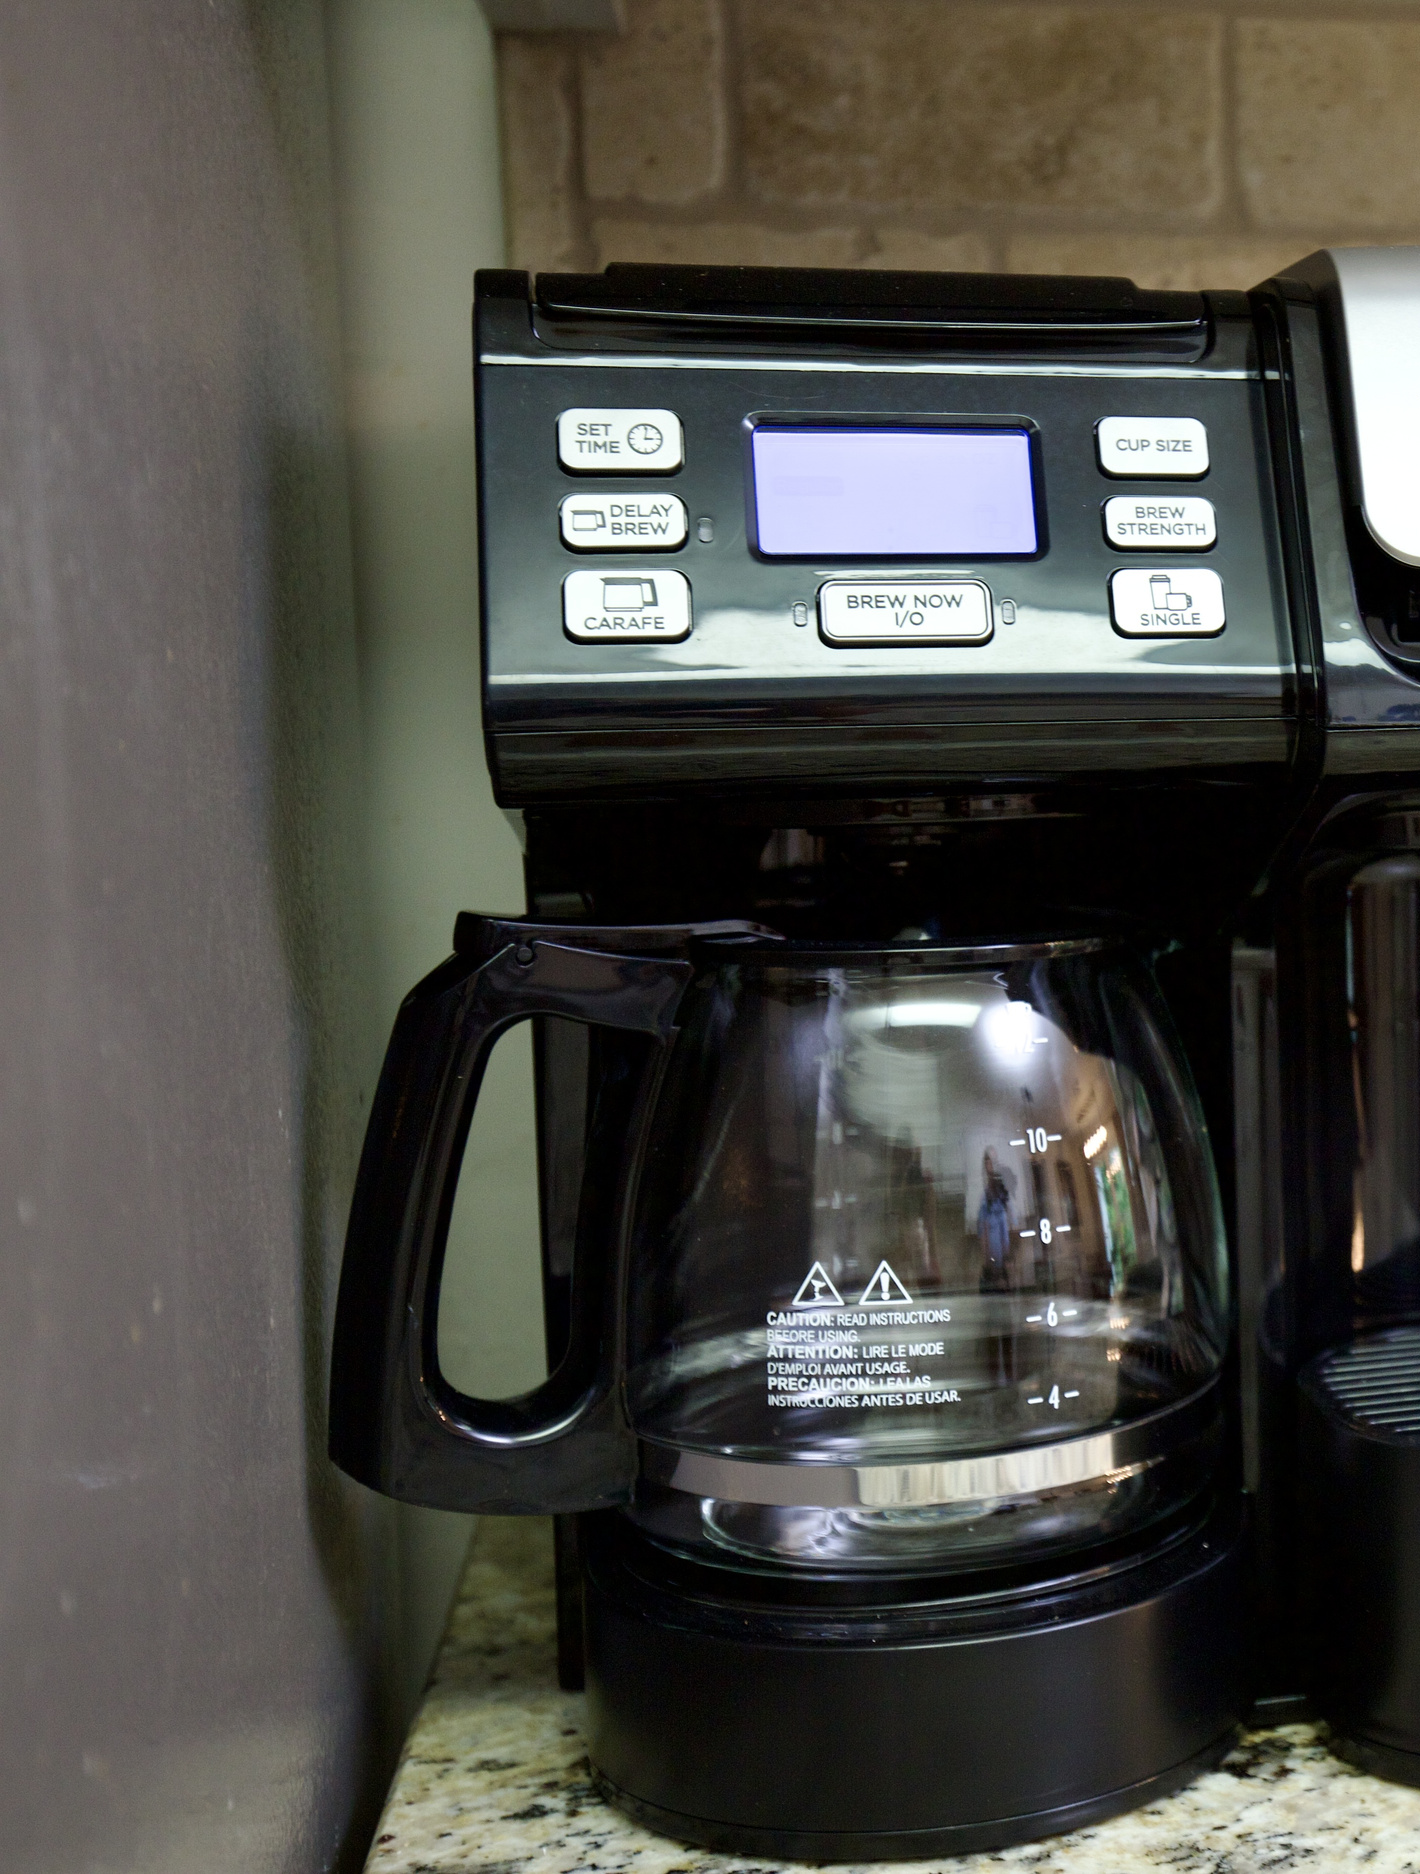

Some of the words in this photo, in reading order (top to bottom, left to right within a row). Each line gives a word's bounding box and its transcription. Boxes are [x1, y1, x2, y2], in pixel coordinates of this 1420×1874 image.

[577, 423, 612, 436] SET
[575, 441, 620, 454] TIME
[1115, 438, 1151, 453] CUP
[1156, 438, 1193, 453] SIZE
[610, 504, 673, 518] DELAY
[1135, 506, 1186, 519] BREW
[611, 522, 669, 535] BREW
[1117, 522, 1207, 536] STRENGTH
[847, 594, 906, 609] BREW
[914, 593, 963, 609] NOW
[584, 617, 665, 630] CARAFE
[895, 611, 924, 627] I/O
[1140, 612, 1202, 626] SINGLE
[766, 1311, 835, 1327] CAUTION:
[836, 1312, 868, 1326] READ
[869, 1309, 951, 1325] INSTRUCTIONS
[818, 1329, 861, 1343] USING.
[766, 1344, 859, 1359] ATTENTION:
[862, 1345, 889, 1359] LIRE
[891, 1344, 907, 1358] LE
[908, 1342, 945, 1357] MODE
[767, 1362, 822, 1376] D'EMPLOI
[822, 1362, 864, 1376] AVANT
[865, 1361, 911, 1375] USAGE.
[767, 1376, 876, 1392] PRECAUCION:
[906, 1375, 932, 1388] LAS
[767, 1394, 859, 1408] INSTRUCCIONES
[860, 1393, 904, 1407] ANTES
[905, 1392, 923, 1406] DE
[924, 1390, 962, 1404] USAR.
